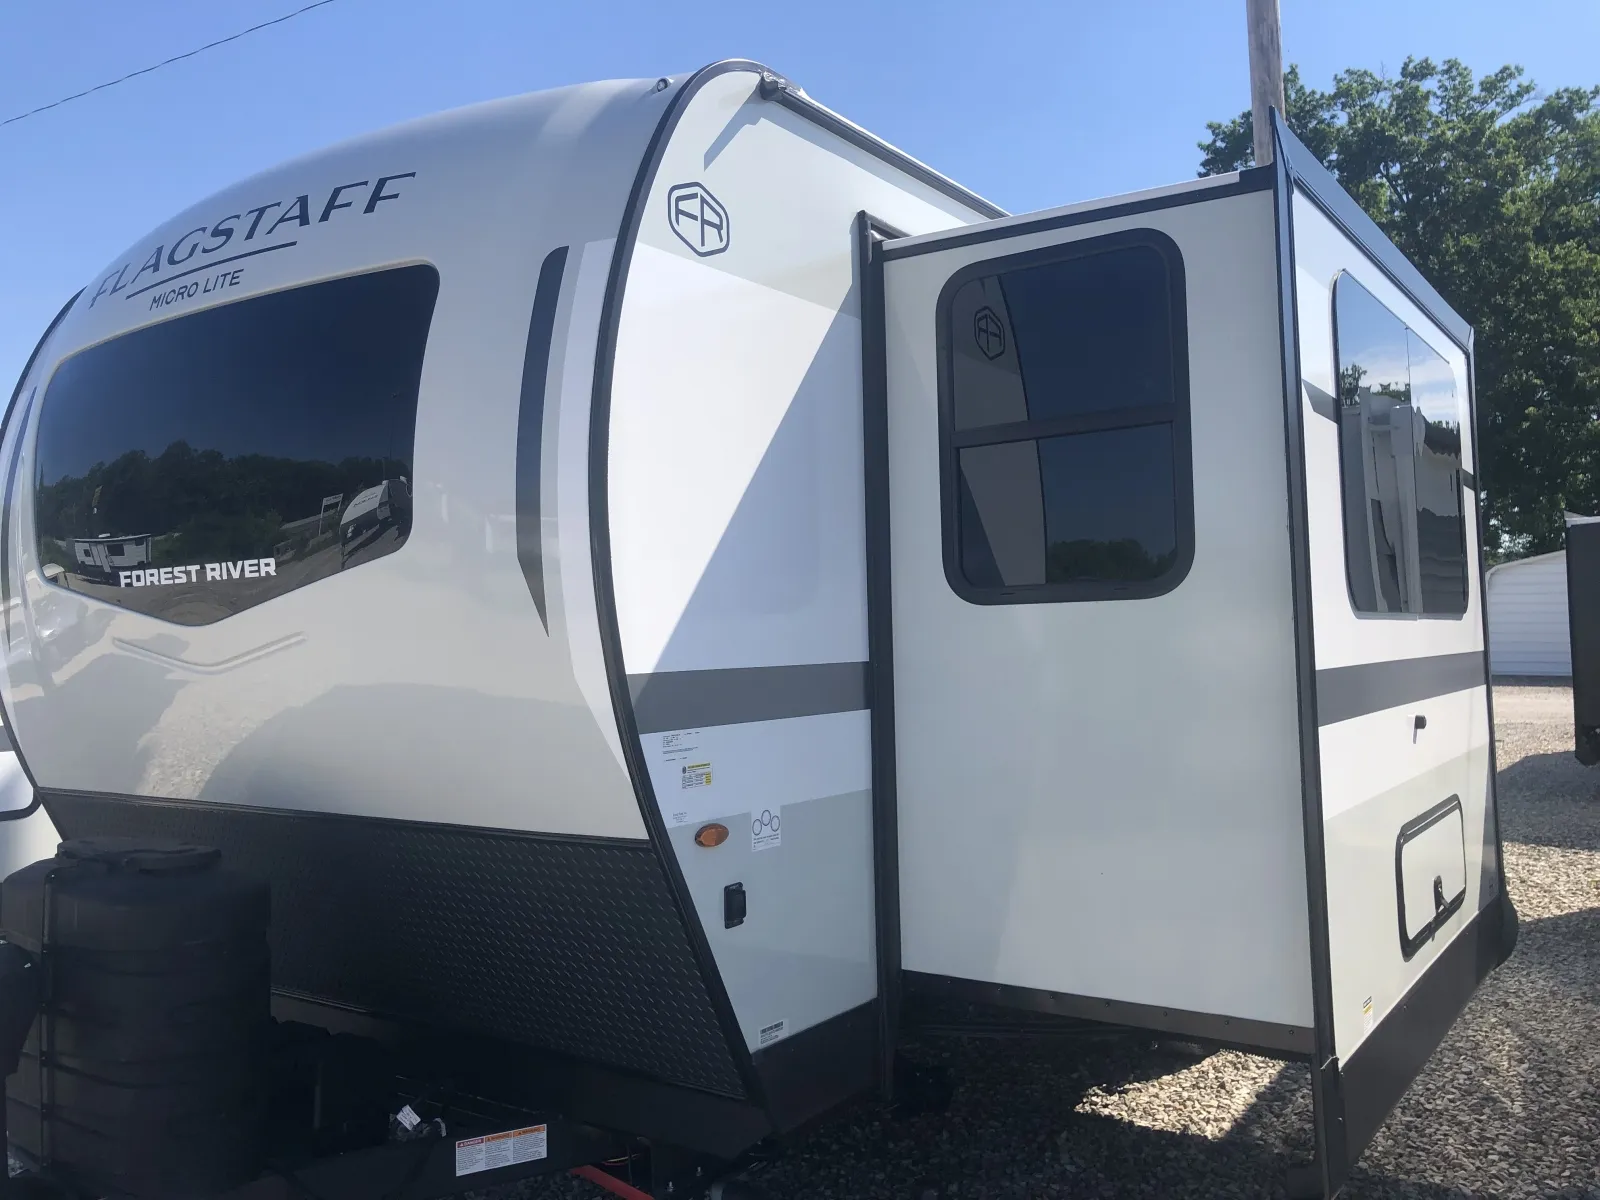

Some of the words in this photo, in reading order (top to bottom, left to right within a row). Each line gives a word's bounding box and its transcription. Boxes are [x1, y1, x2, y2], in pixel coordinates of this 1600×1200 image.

[89, 171, 417, 309] FLAGSTAFF
[149, 281, 199, 311] MICRO
[202, 268, 245, 293] LITE
[118, 564, 201, 588] FOREST
[204, 557, 277, 582] RIVER
